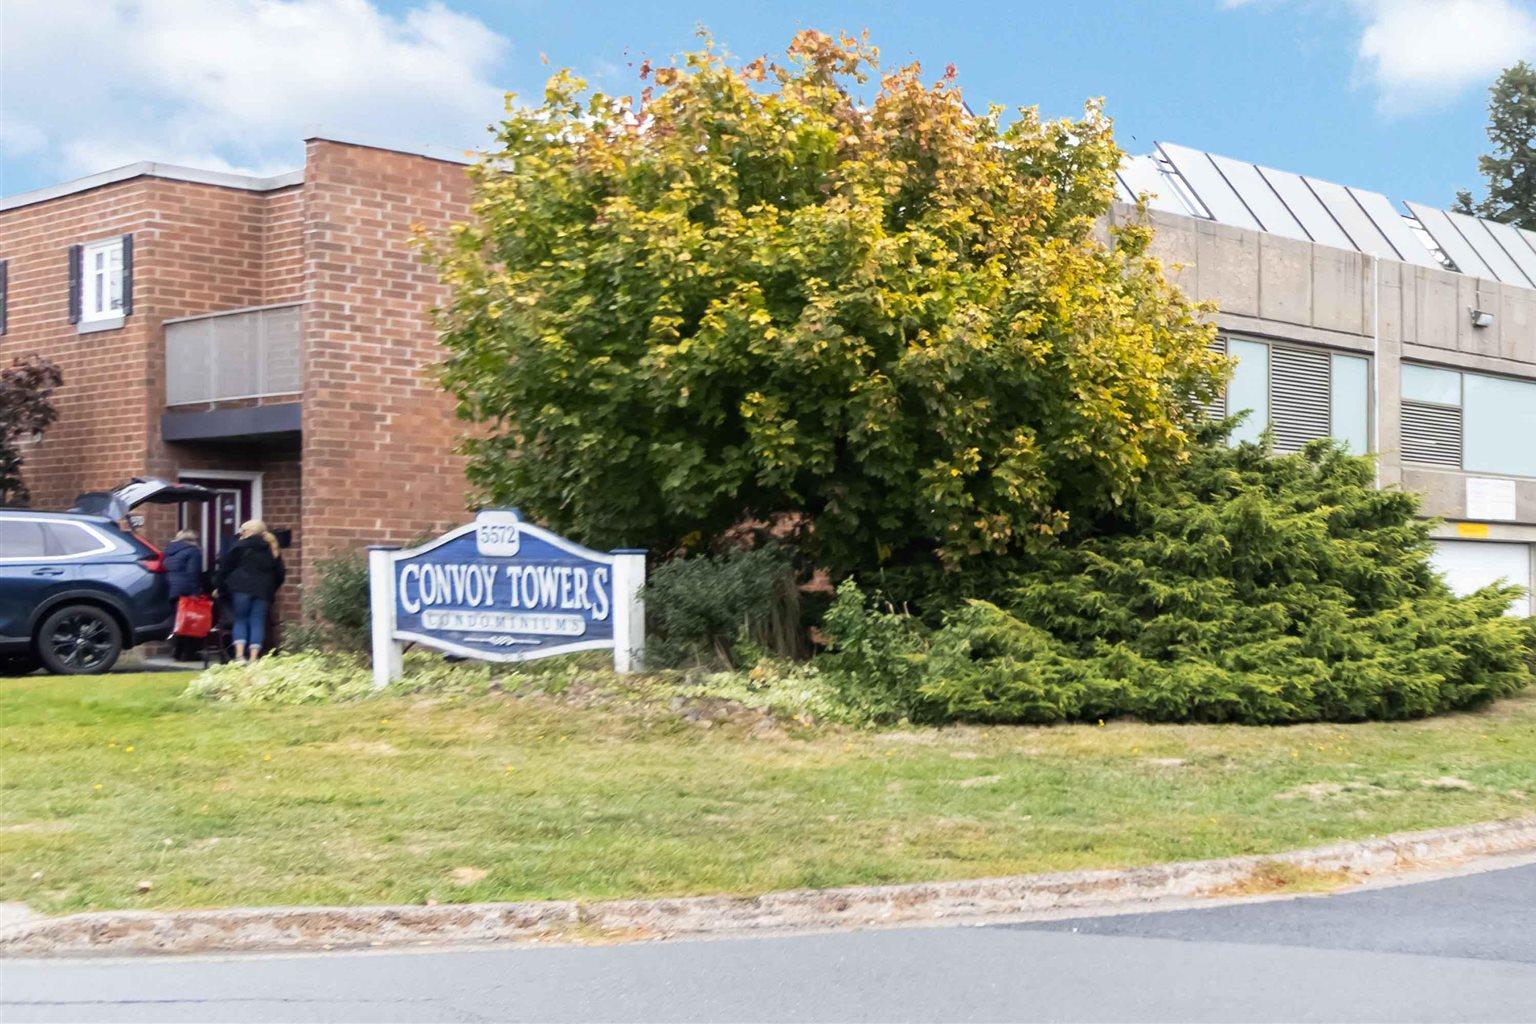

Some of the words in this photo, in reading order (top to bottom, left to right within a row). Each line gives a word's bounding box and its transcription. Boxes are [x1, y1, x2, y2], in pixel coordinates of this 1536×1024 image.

[481, 525, 516, 544] 5572
[400, 563, 498, 614] CONVOY
[506, 565, 609, 621] TOWERS
[428, 612, 580, 632] CONDOMINIUMS
